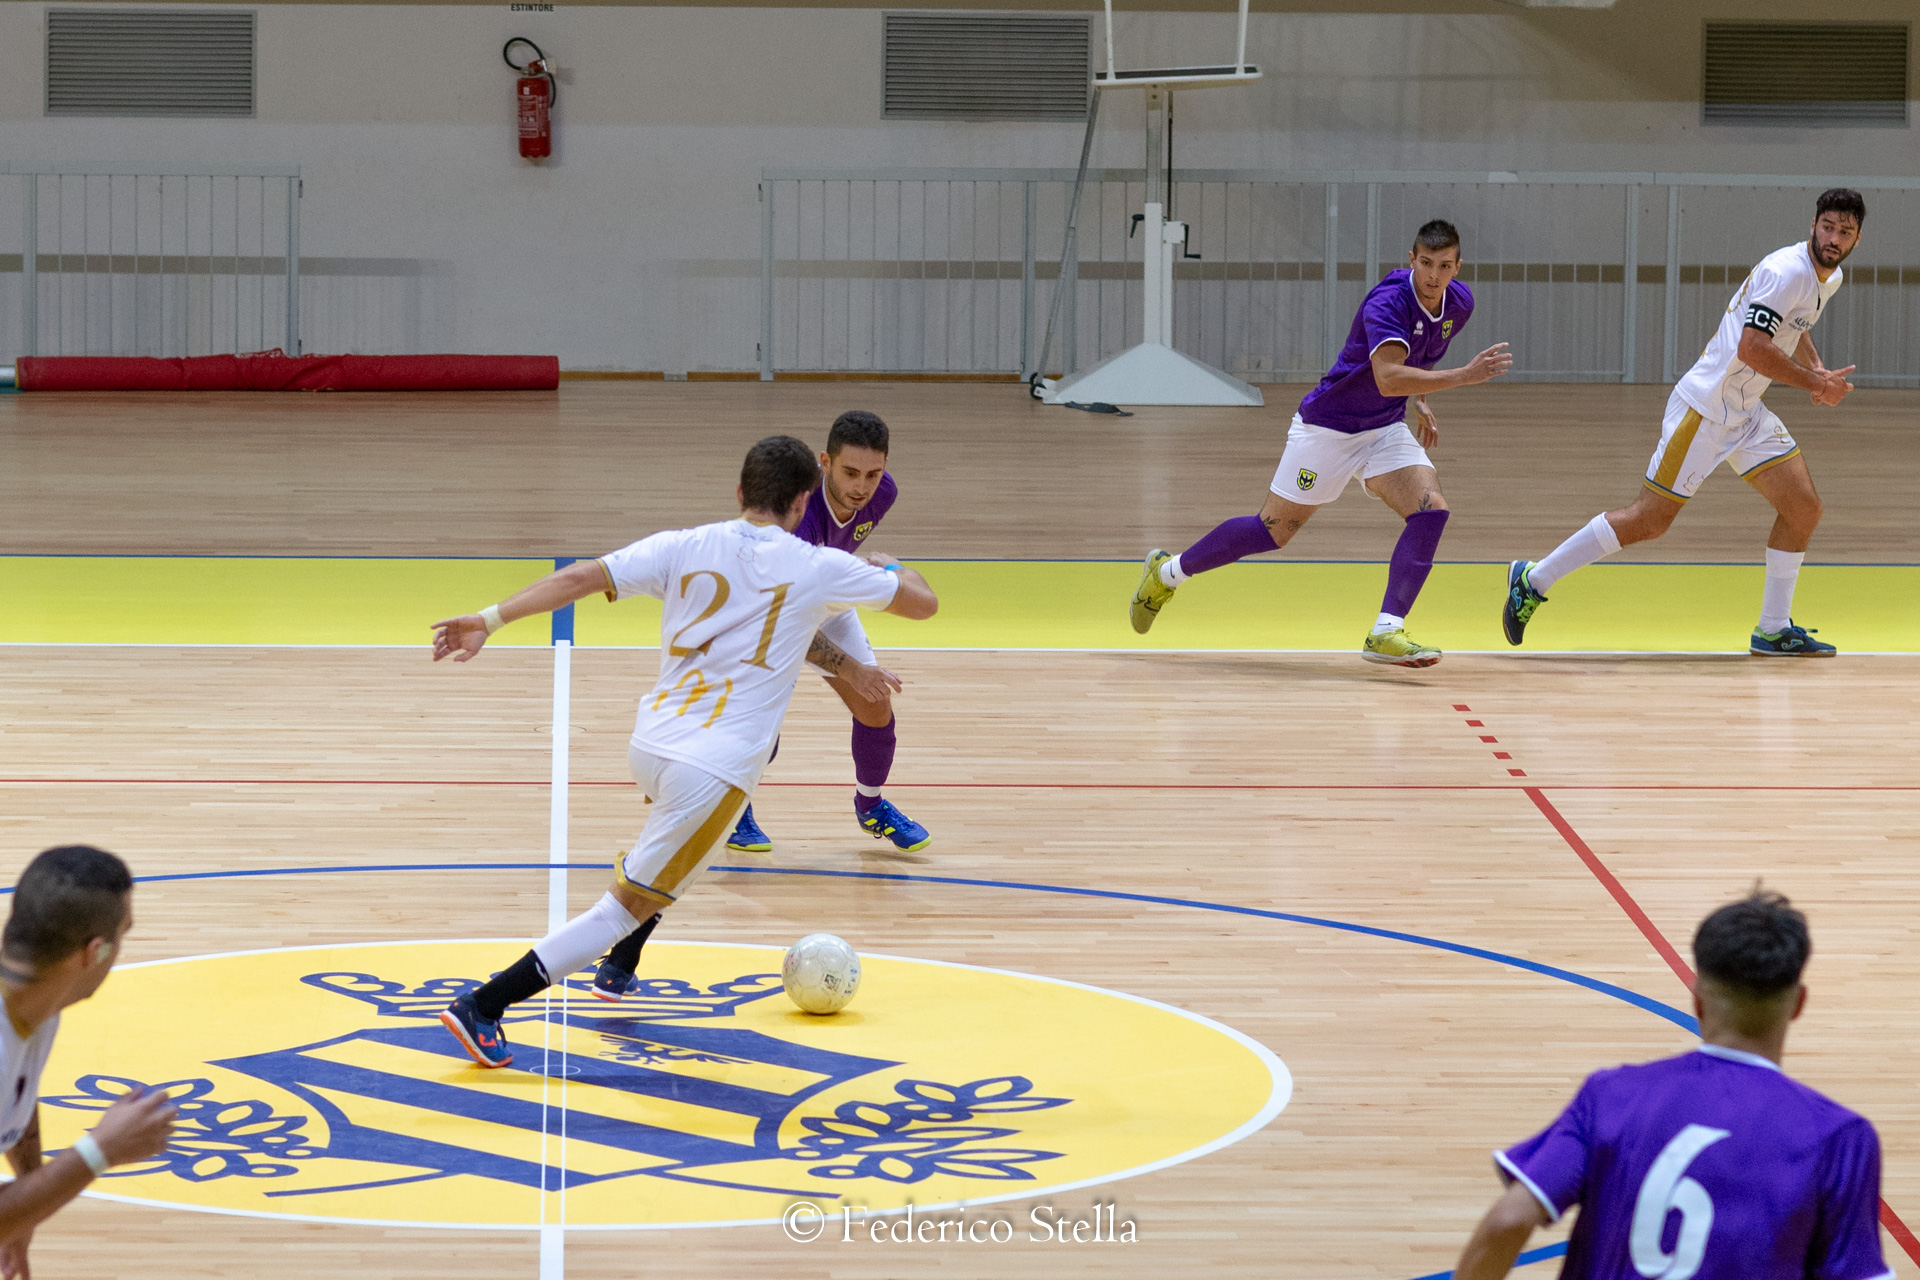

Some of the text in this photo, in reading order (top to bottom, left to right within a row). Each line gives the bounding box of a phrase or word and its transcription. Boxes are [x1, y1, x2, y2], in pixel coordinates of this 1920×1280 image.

[511, 4, 554, 12] ESTINTORE
[1754, 309, 1770, 328] C
[669, 570, 795, 671] 21
[1629, 1123, 1732, 1280] 6
